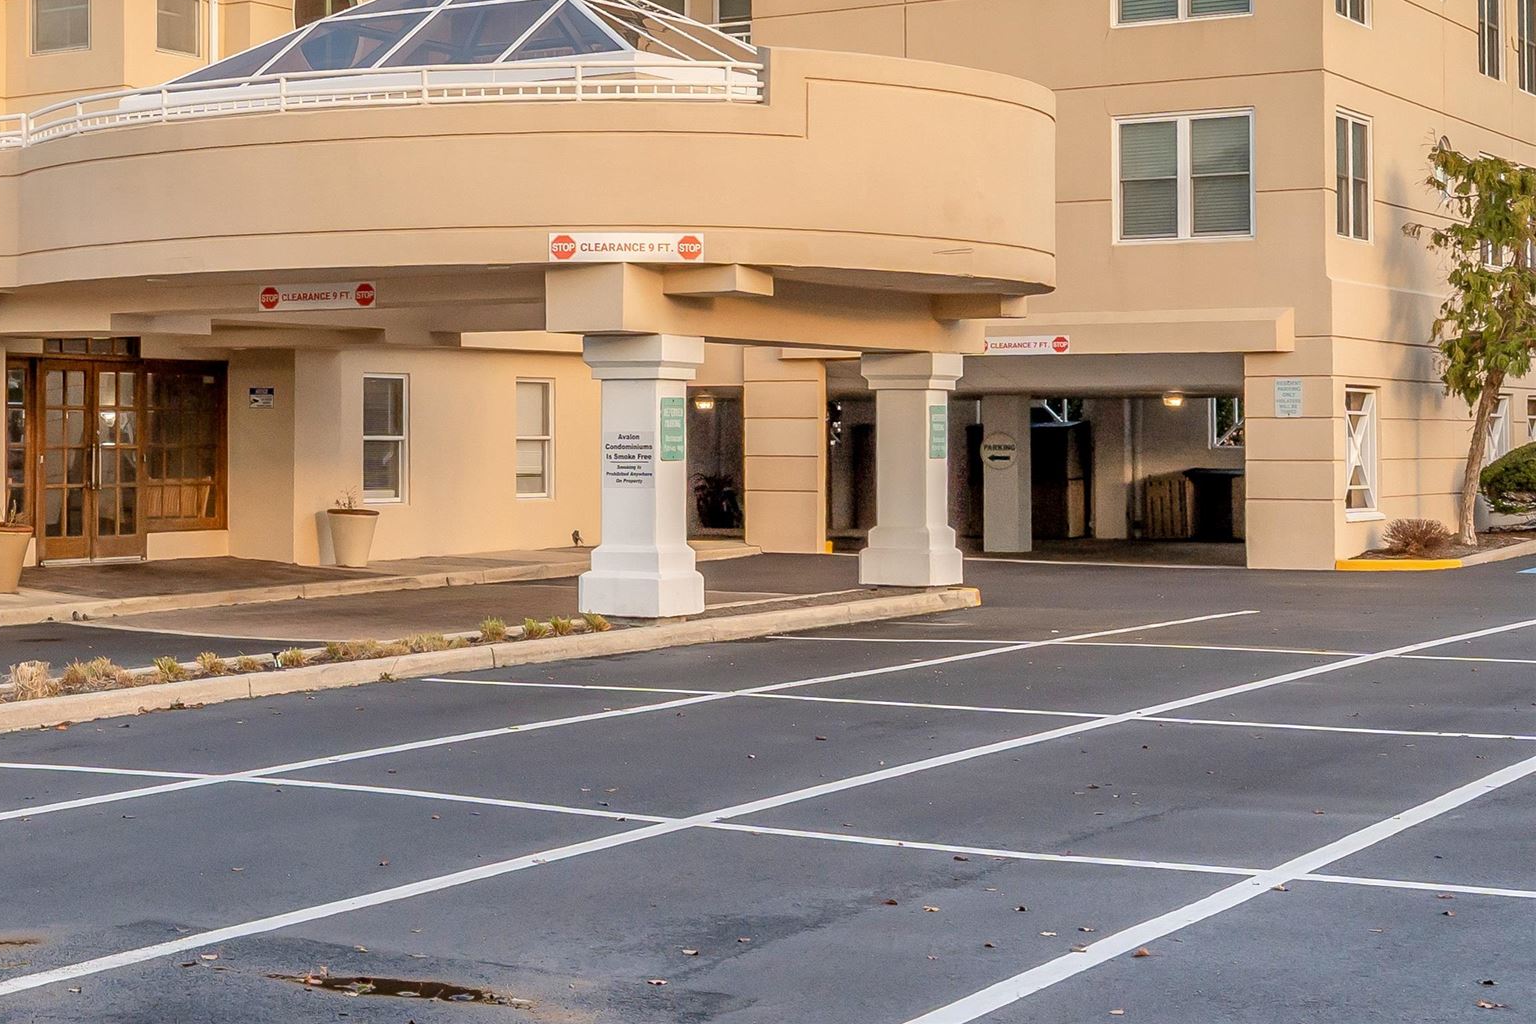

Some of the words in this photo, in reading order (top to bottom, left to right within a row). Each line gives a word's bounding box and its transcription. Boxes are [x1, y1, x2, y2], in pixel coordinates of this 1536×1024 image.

[551, 242, 576, 252] STOP
[580, 242, 646, 252] CLEARANCE
[648, 242, 655, 252] 9
[657, 243, 674, 252] FT.
[677, 243, 702, 253] STOP
[261, 293, 278, 303] STOP
[281, 291, 330, 301] CLEARANCE
[332, 291, 338, 300] 9
[339, 291, 352, 300] FT.
[356, 290, 375, 299] STOP
